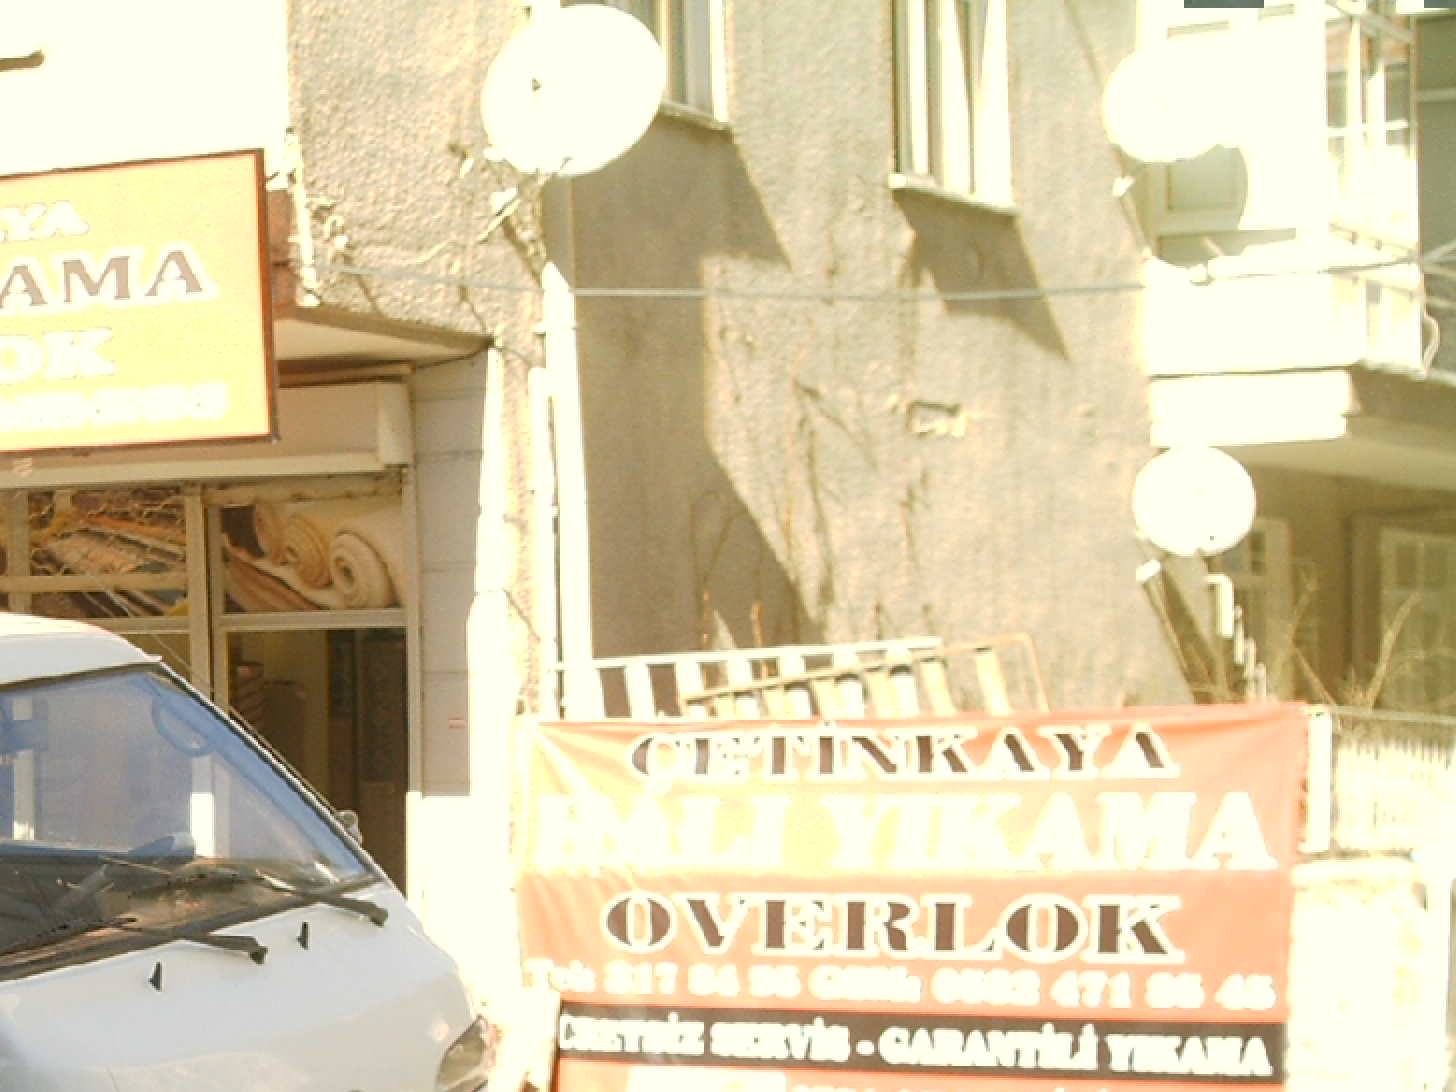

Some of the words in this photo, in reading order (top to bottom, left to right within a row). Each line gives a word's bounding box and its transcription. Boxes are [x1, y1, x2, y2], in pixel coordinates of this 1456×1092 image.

[532, 793, 782, 866] HALI
[818, 791, 1279, 870] YIKAMA
[600, 890, 1184, 964] OVERLOK
[604, 960, 679, 995] 317
[1049, 970, 1131, 1008] 471
